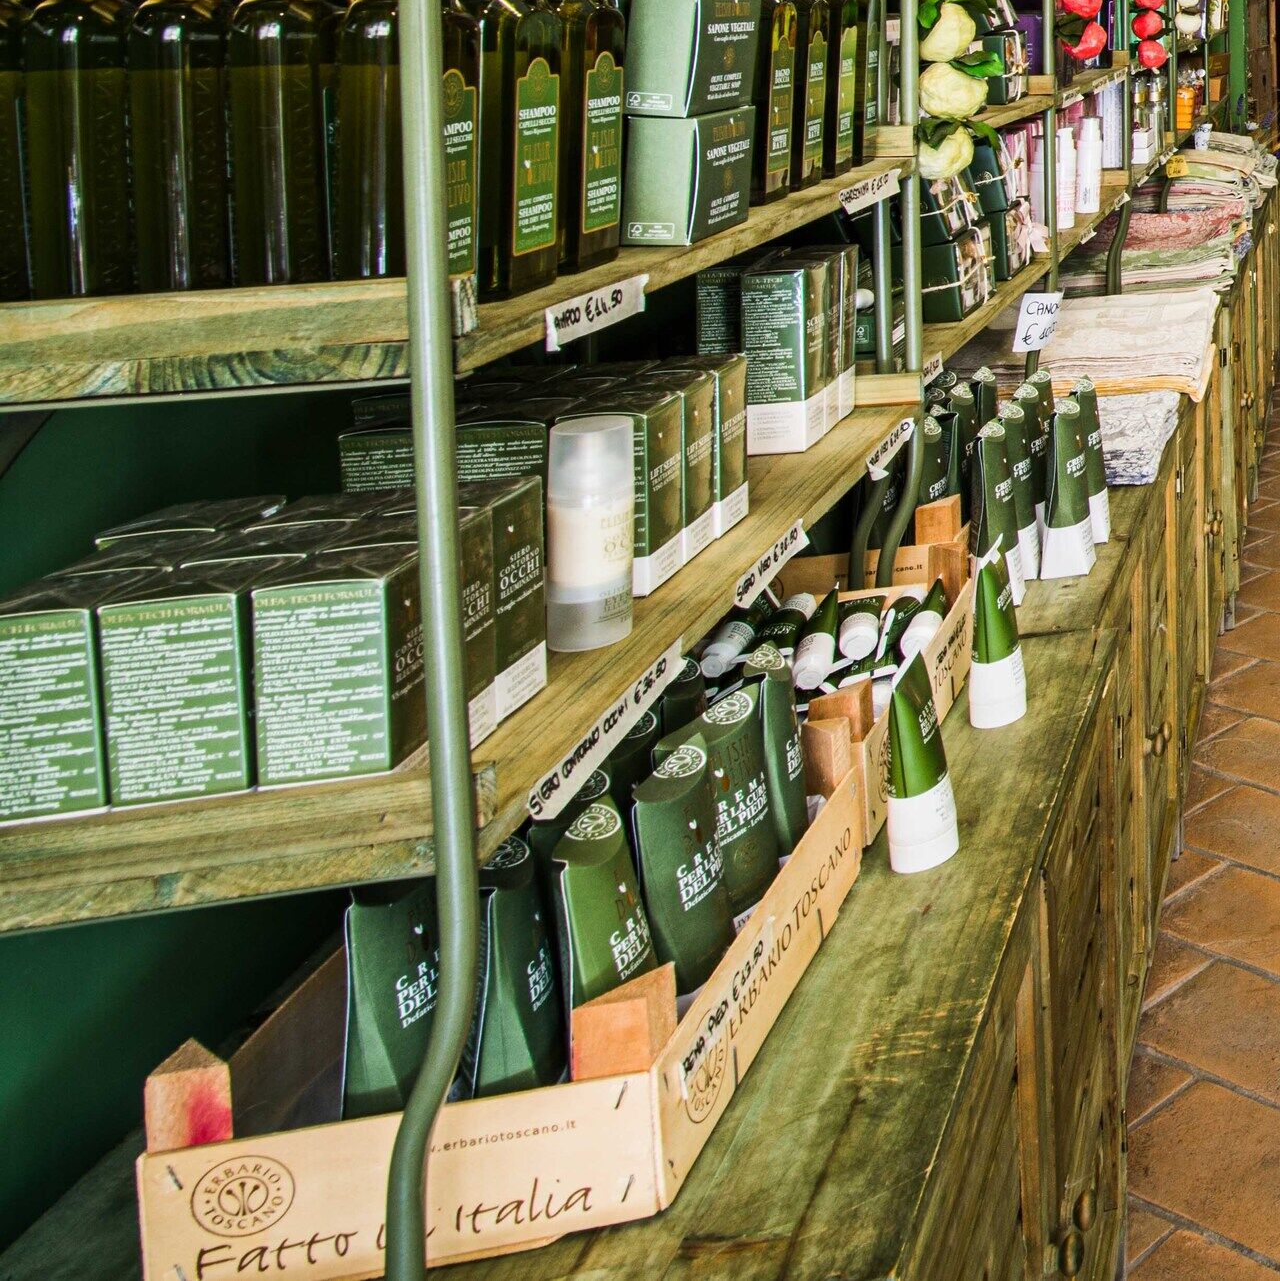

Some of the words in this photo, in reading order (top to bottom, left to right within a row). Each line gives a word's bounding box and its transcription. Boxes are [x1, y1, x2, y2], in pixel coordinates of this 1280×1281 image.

[707, 23, 730, 35] SAPONE
[730, 21, 755, 33] VEGETALE
[518, 104, 556, 121] SHAMPOO
[588, 96, 621, 109] SHAMPOO
[707, 147, 728, 160] SAPONE
[728, 138, 751, 154] VEGETALE
[587, 184, 617, 200] SHAMPOO
[518, 201, 553, 217] SHAMPOO
[500, 548, 540, 577] CONTORNO
[510, 545, 531, 562] SIERO
[499, 559, 540, 590] OCCHI
[746, 783, 767, 810] CURA
[739, 795, 768, 827] PIEDE
[679, 865, 704, 893] PER
[681, 876, 705, 901] DEL
[728, 922, 793, 1039] ERBARIO
[793, 826, 853, 930] TOSCANO
[612, 936, 634, 959] PER
[615, 948, 639, 973] DEL
[397, 980, 423, 1005] PER
[399, 989, 432, 1018] DEL
[429, 1120, 577, 1154] .erbariotoscano.it
[205, 1163, 281, 1198] ERBARIO
[205, 1194, 285, 1230] TOSCANO
[196, 1230, 357, 1281] Fatto
[455, 1177, 594, 1236] Italia
